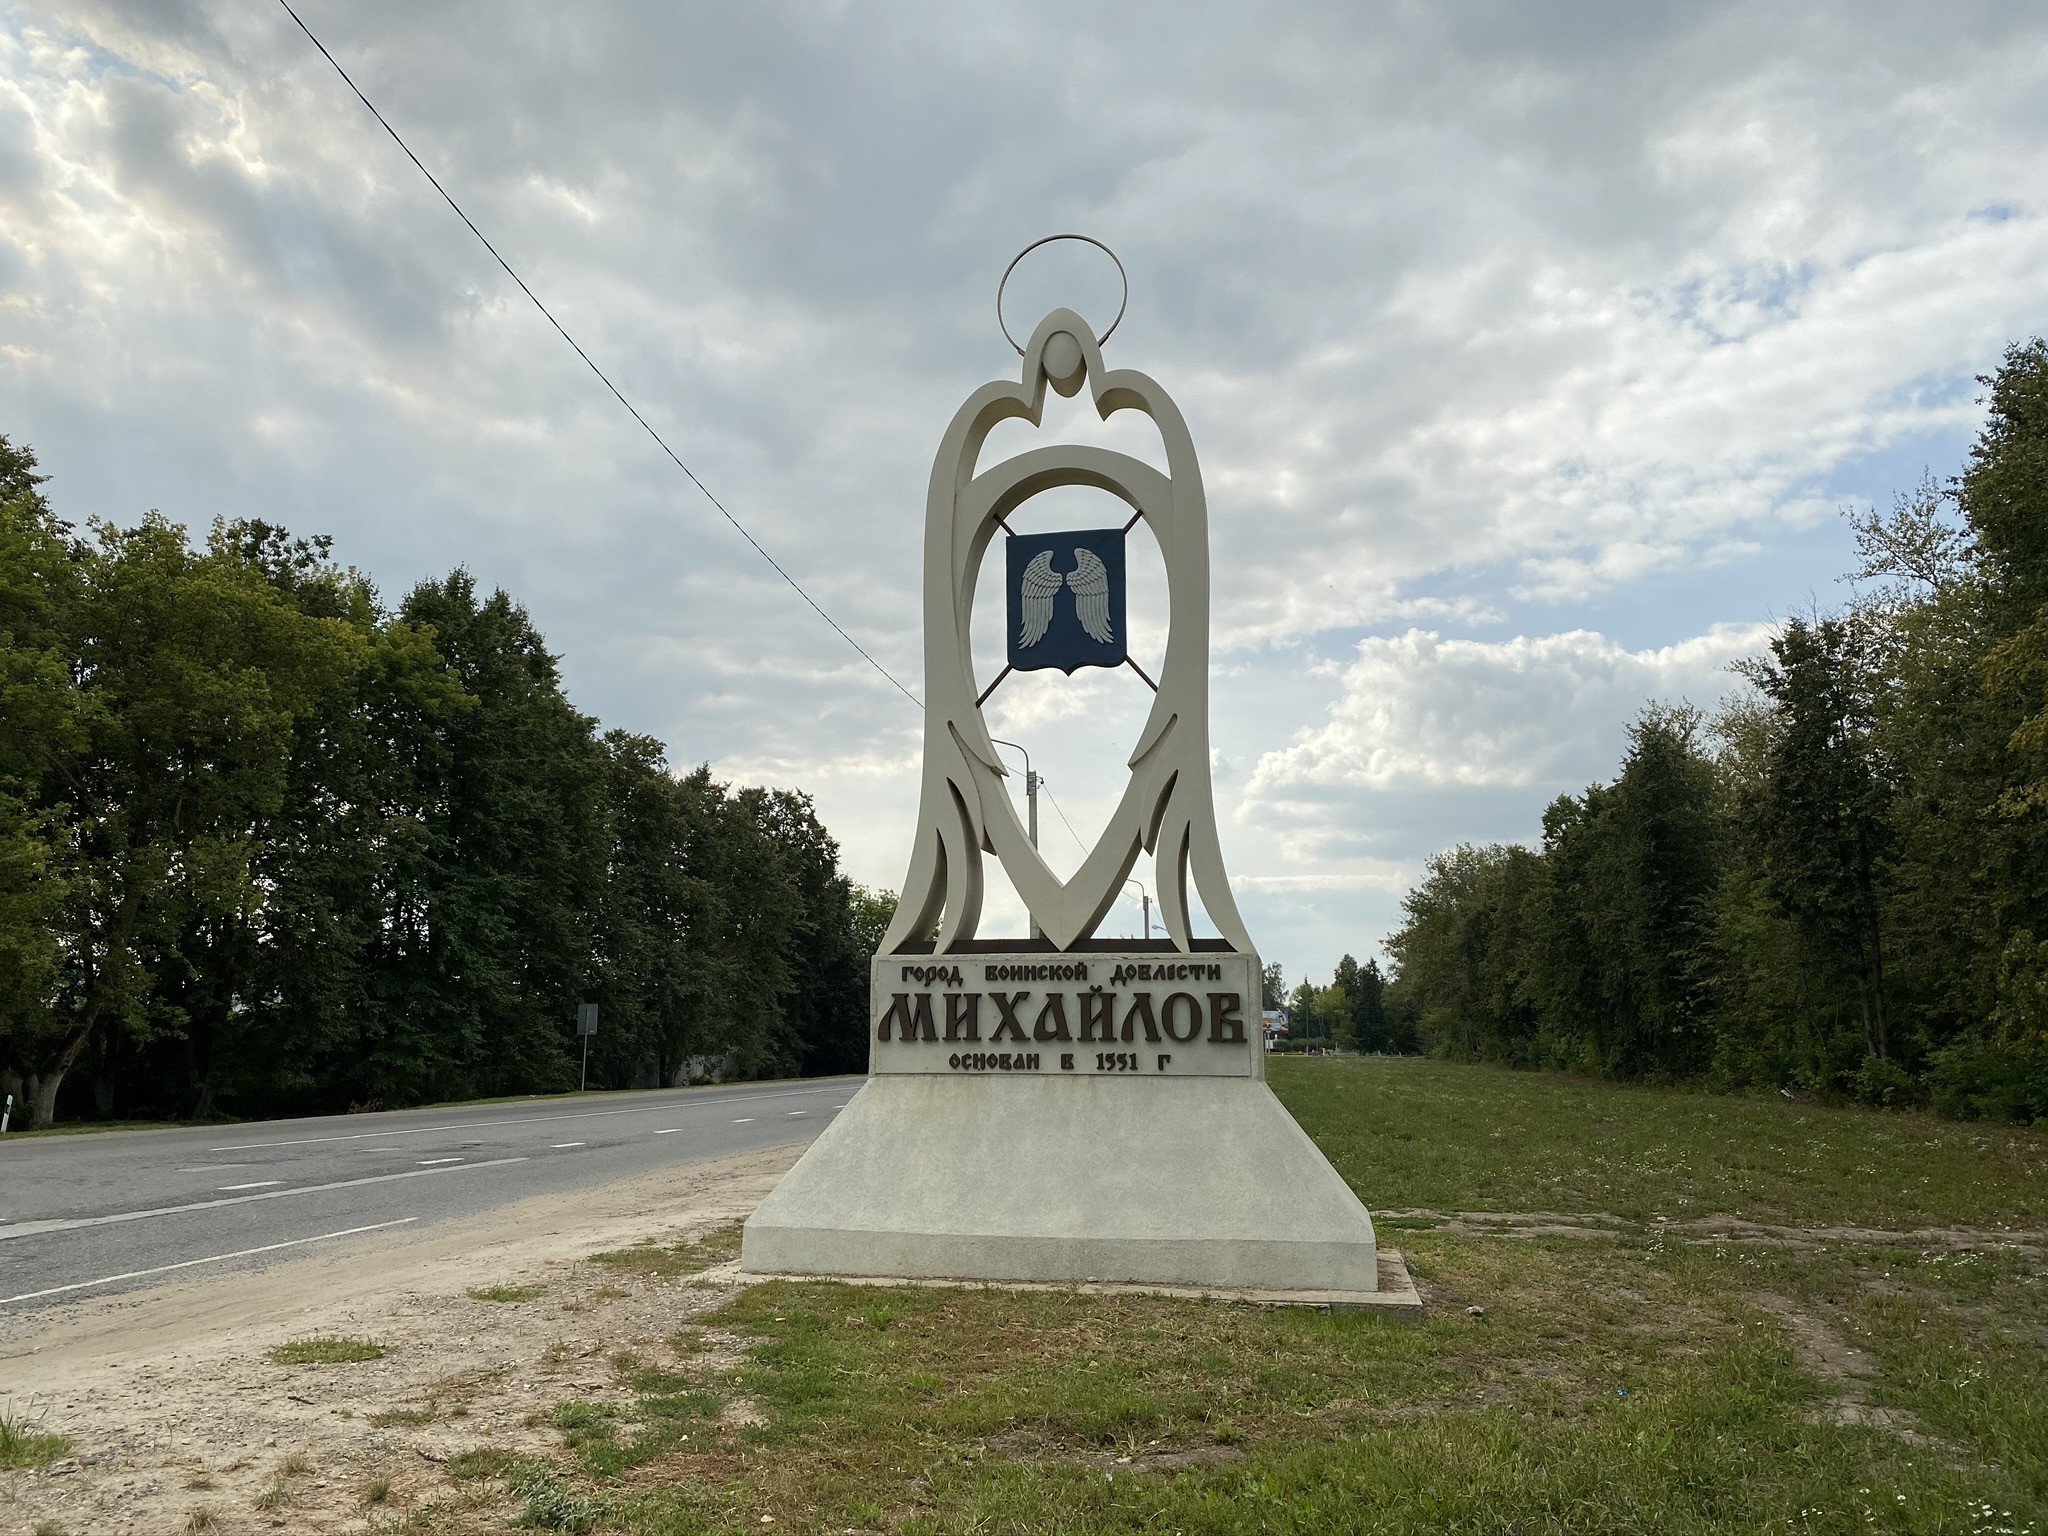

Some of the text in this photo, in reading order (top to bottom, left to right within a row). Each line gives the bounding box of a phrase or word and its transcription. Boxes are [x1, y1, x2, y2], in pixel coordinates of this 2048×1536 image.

[902, 966, 963, 987] ГОРОД
[985, 962, 1088, 981] ВОИНСКОЙ
[878, 985, 1248, 1043] МИХАЙЛОВ
[949, 1053, 1040, 1071] ОСНОВАН
[1060, 1053, 1075, 1070] В
[1096, 1053, 1138, 1071] 1551
